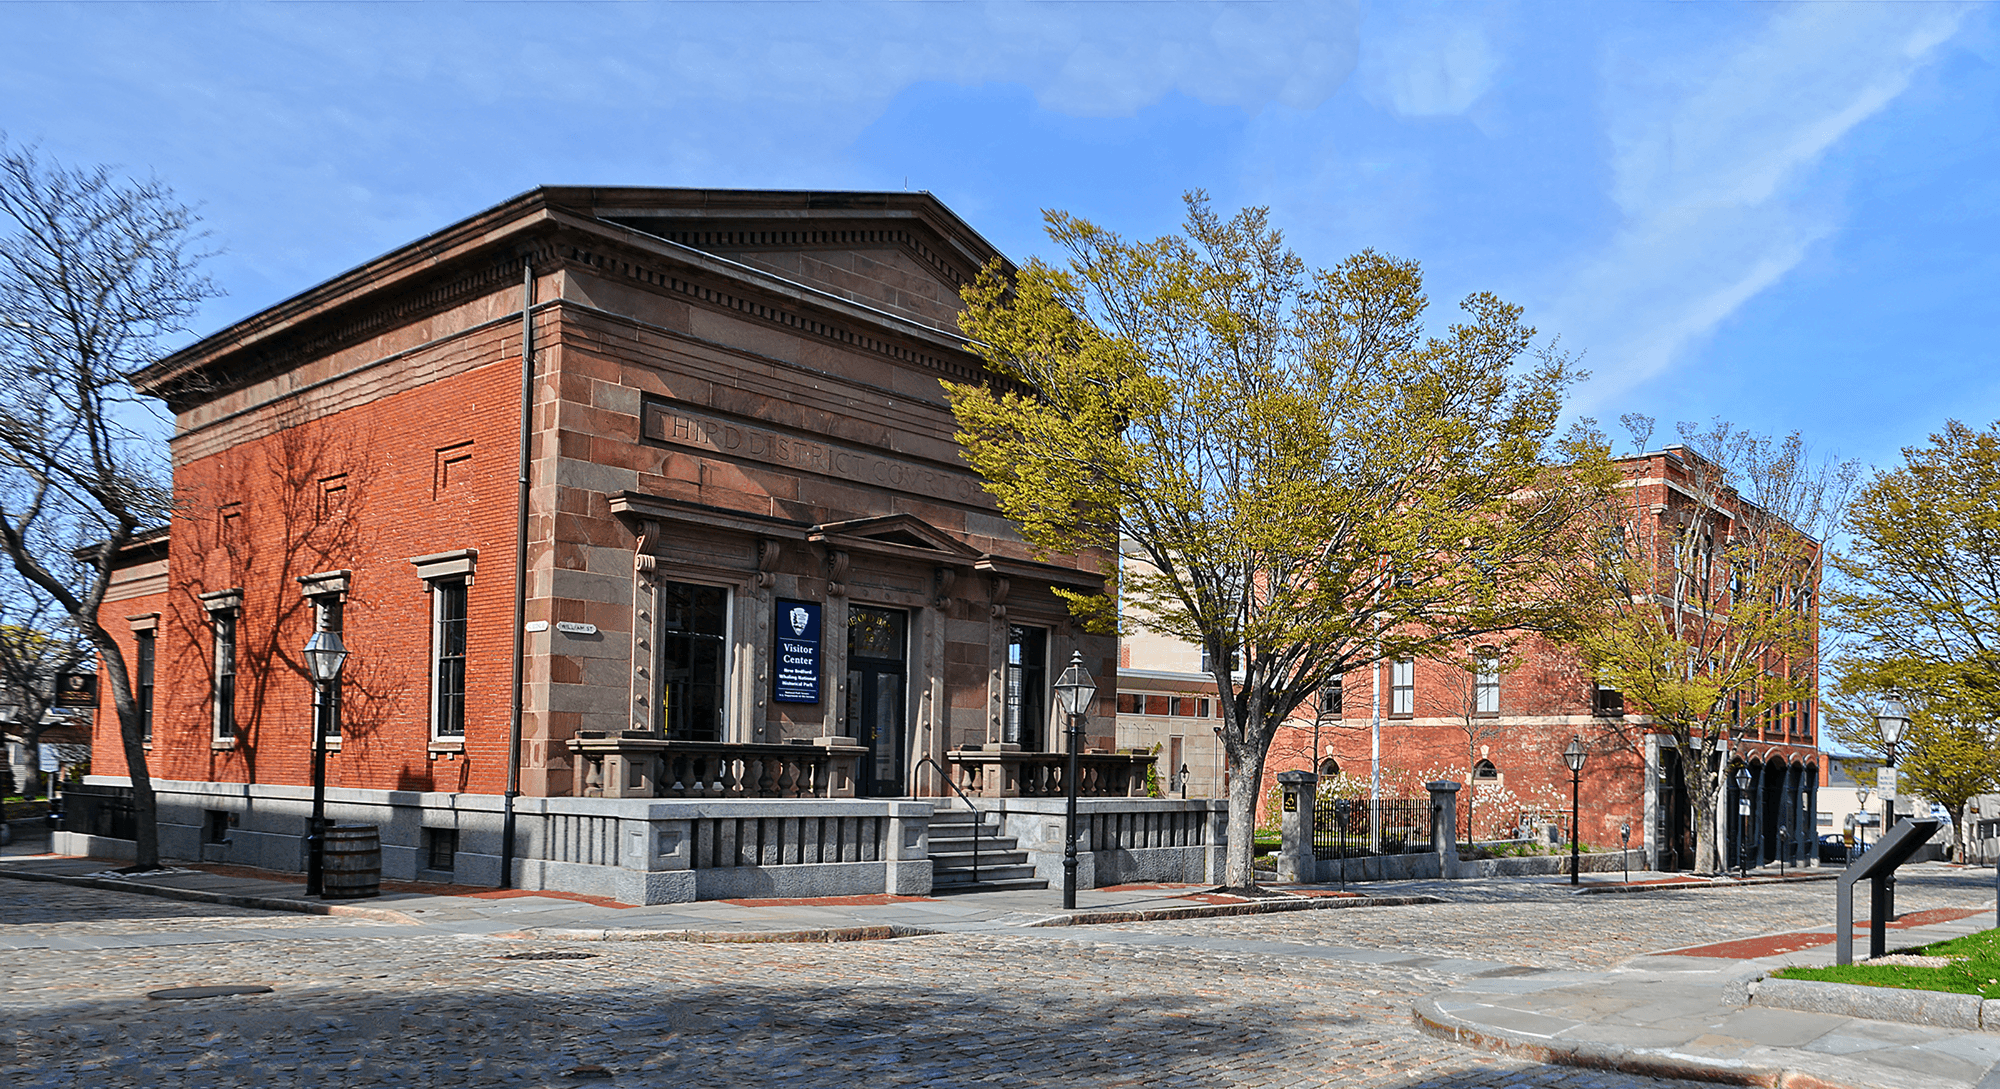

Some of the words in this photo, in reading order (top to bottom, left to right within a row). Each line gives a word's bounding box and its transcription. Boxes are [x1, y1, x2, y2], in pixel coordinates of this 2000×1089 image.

[653, 408, 741, 450] THIRD
[749, 431, 866, 477] DISTRICT
[783, 642, 813, 654] Visitor
[783, 654, 813, 665] Center
